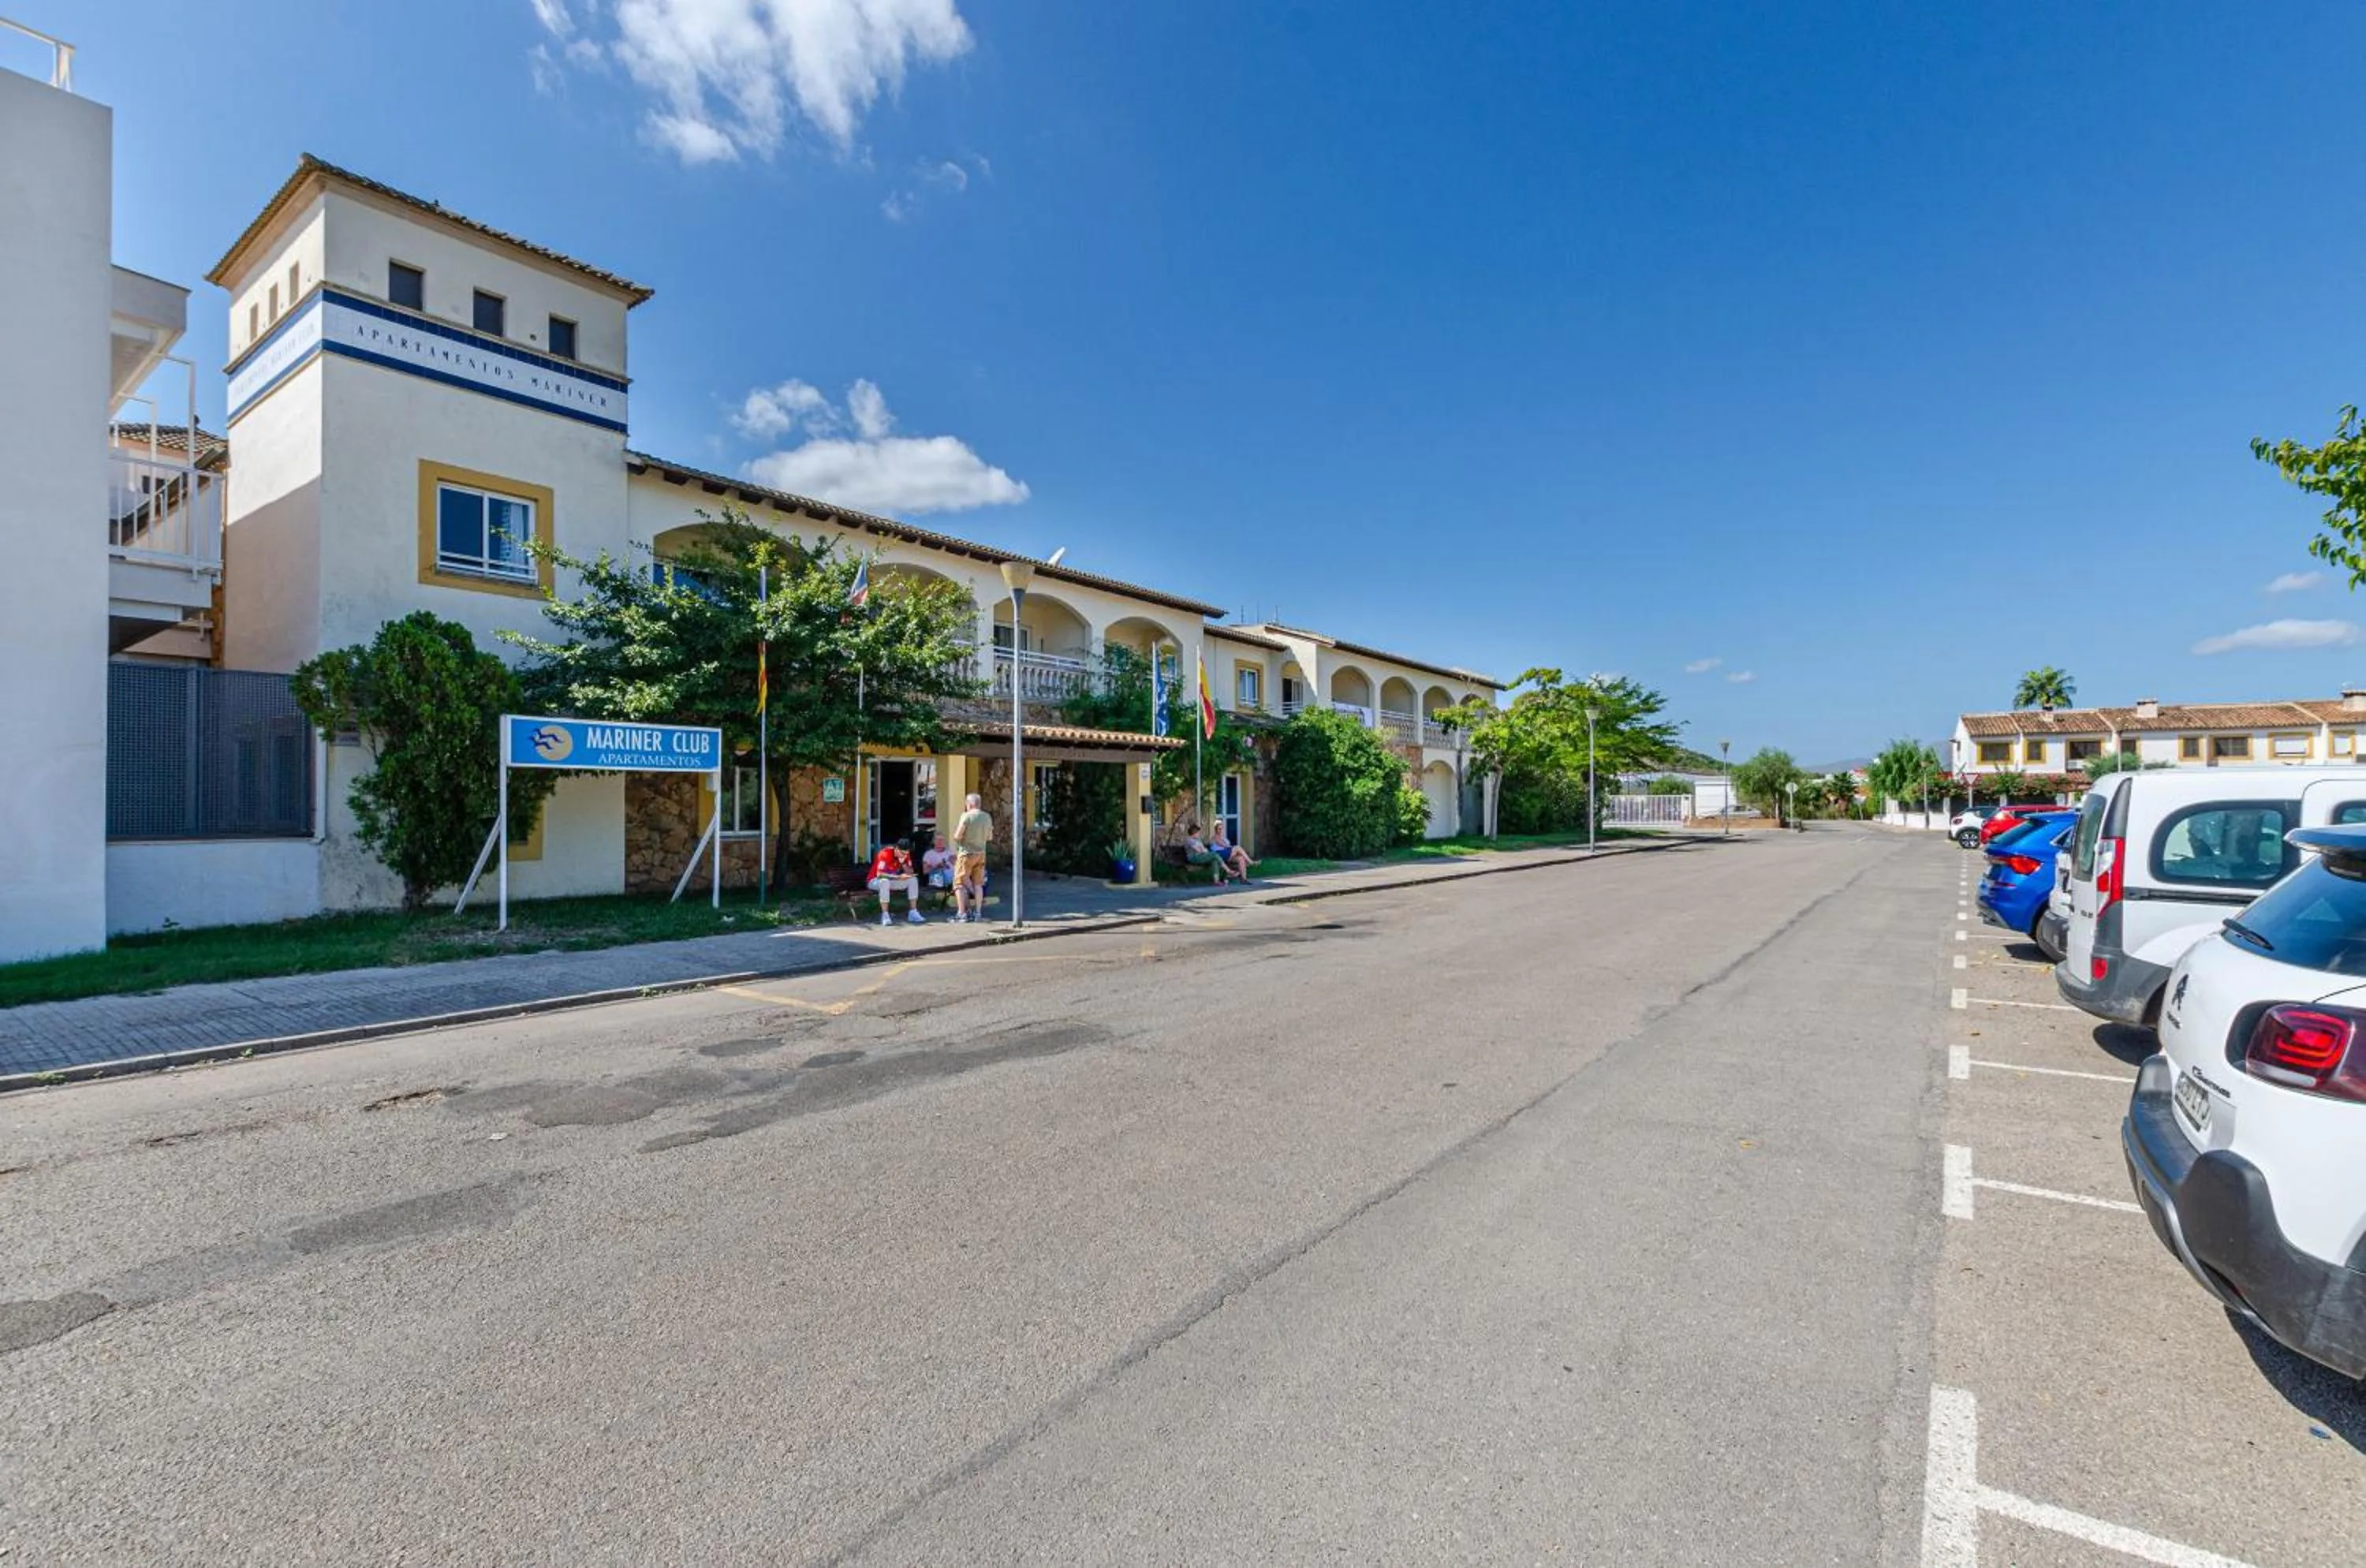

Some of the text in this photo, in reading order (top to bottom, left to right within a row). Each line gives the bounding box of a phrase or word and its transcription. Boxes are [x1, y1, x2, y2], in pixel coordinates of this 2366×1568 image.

[357, 324, 514, 380] APARTAMENTOS
[531, 376, 606, 407] MARINER
[586, 726, 710, 754] MARINER CLUB
[597, 752, 702, 767] APARTAMENTOS
